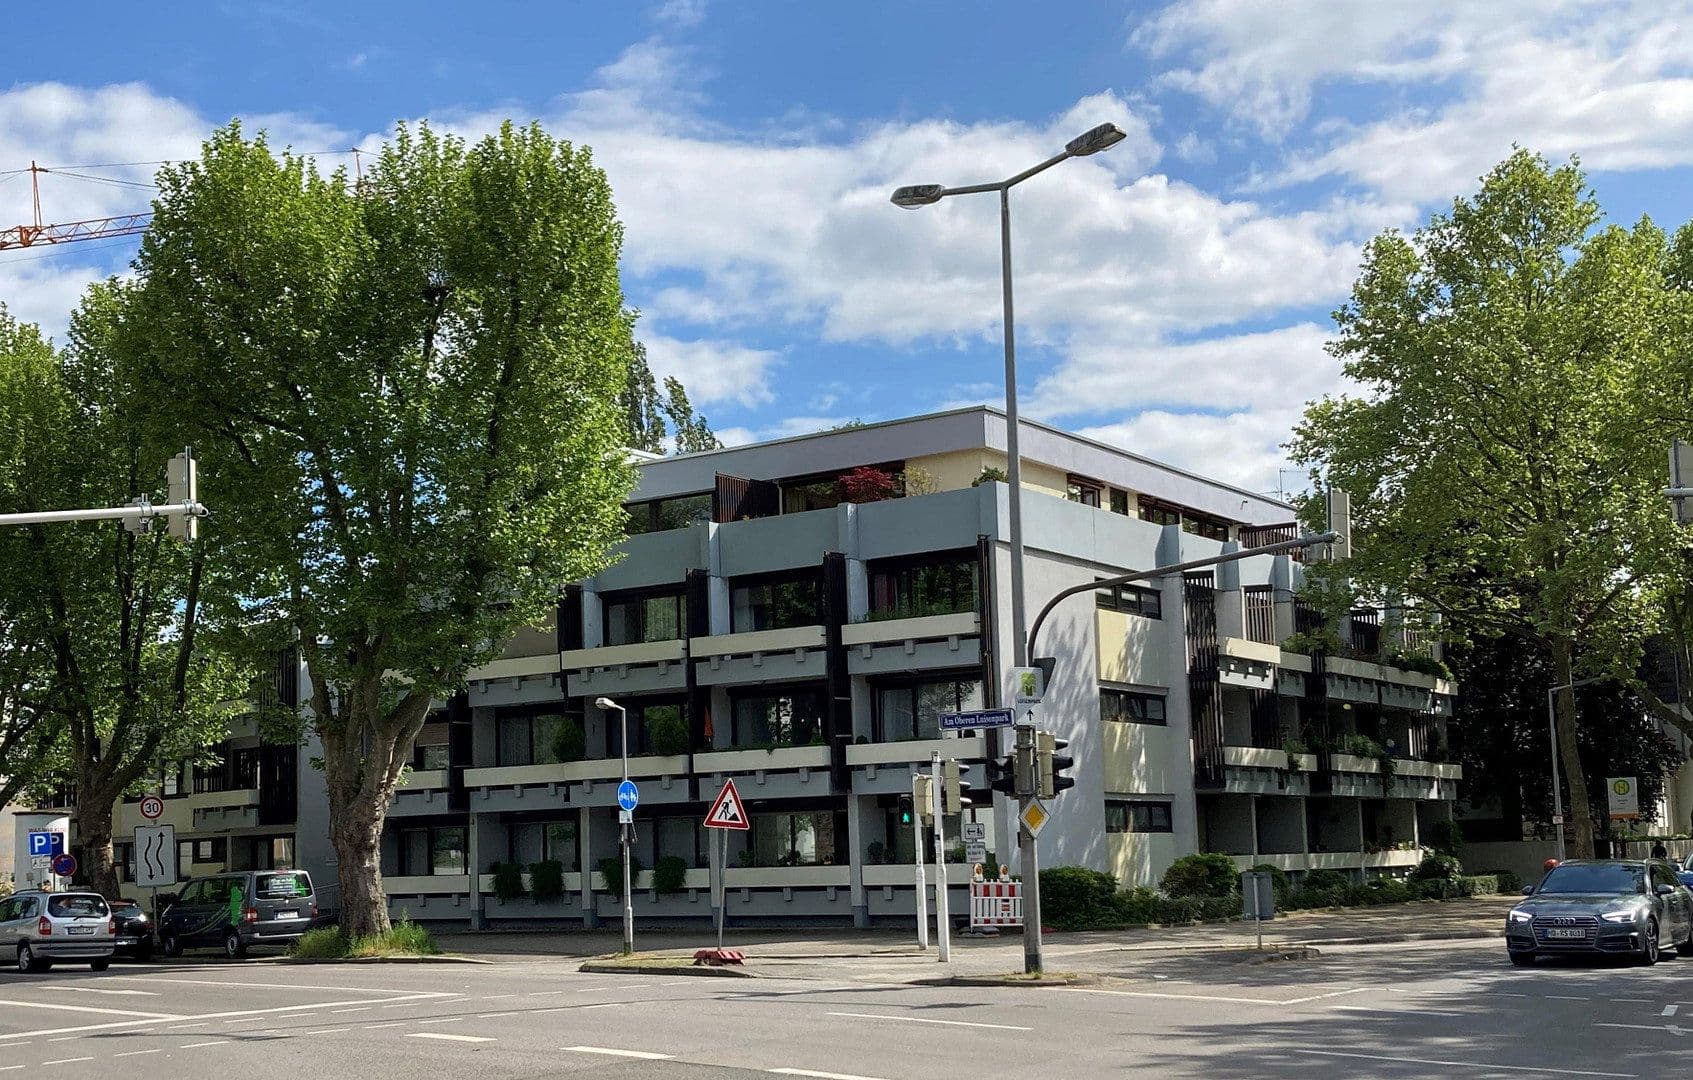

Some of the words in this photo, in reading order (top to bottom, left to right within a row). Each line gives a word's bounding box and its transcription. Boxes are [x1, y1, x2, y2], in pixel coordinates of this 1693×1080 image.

[943, 717, 954, 726] Am
[954, 715, 976, 725] Oberen
[976, 713, 1009, 724] Luisenpark
[145, 802, 159, 814] 30
[34, 835, 47, 853] P
